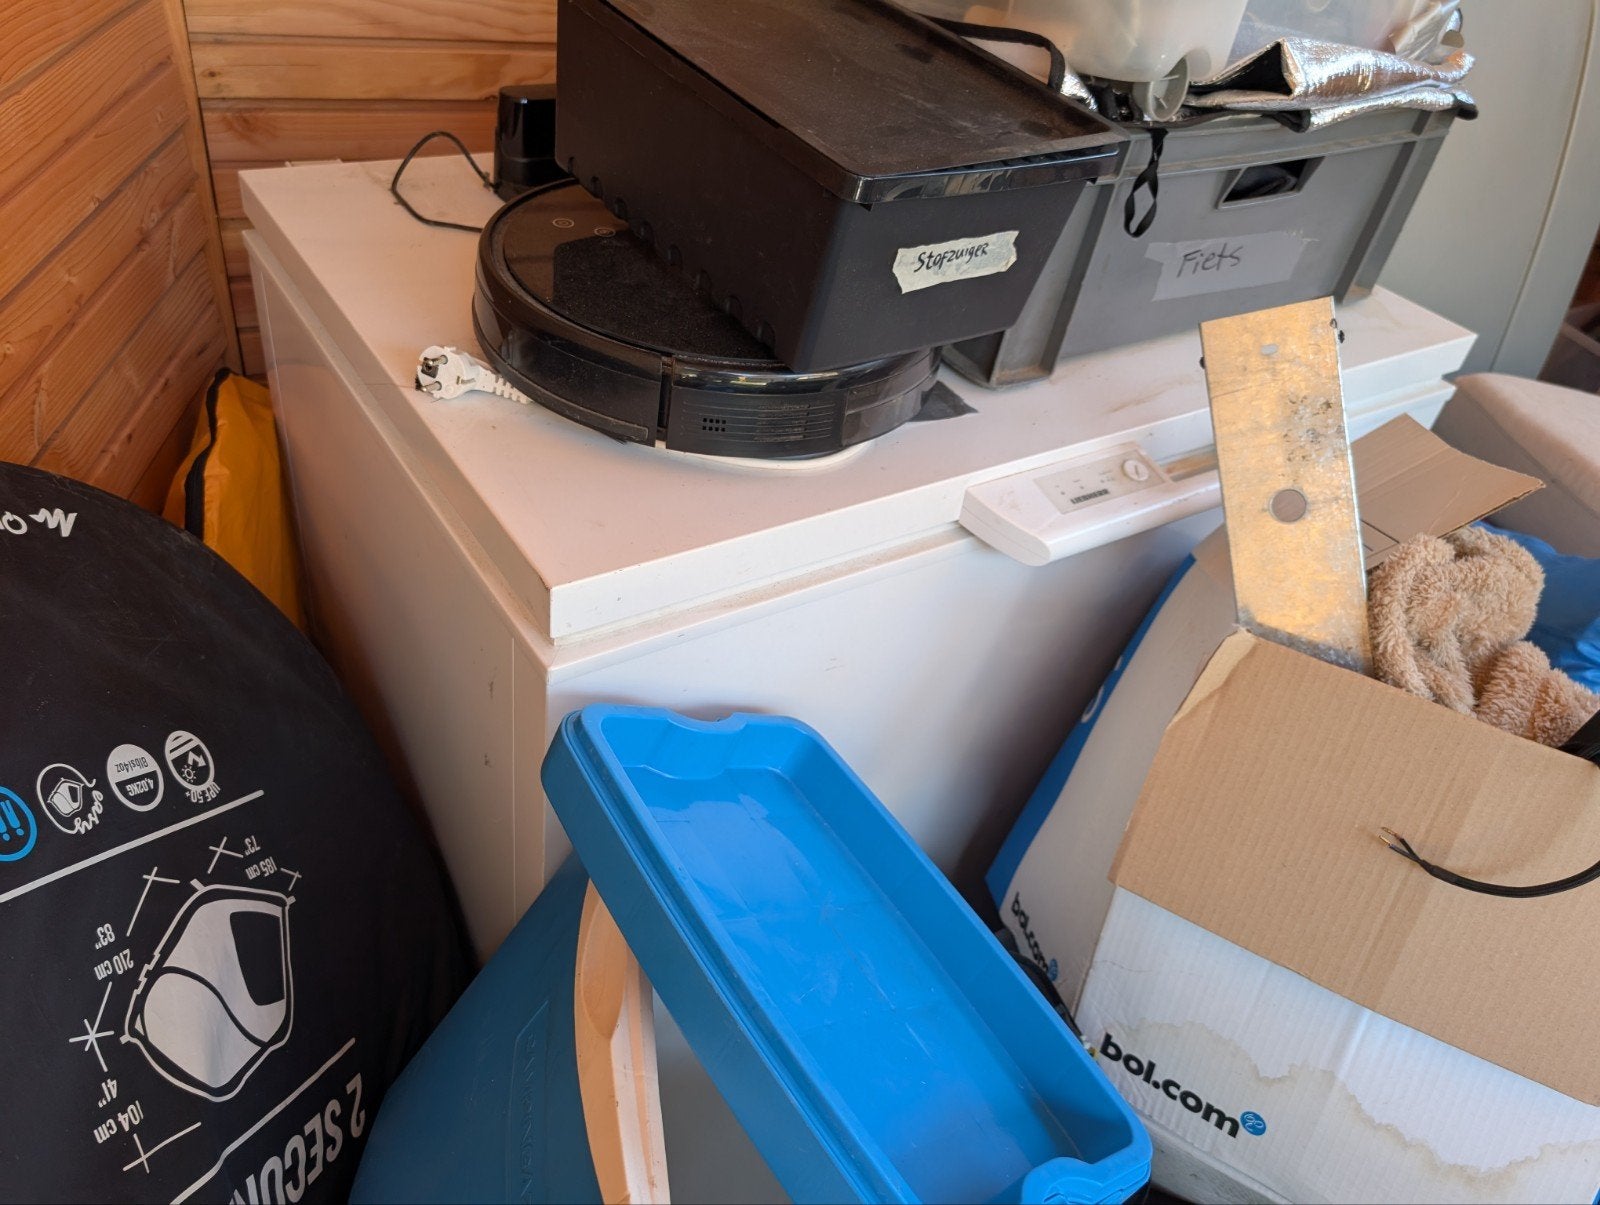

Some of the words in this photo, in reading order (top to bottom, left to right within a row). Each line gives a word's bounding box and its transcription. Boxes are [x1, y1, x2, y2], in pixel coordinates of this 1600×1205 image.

[1176, 242, 1243, 278] Fiets
[125, 778, 154, 797] 4,02KG
[206, 781, 221, 802] UPF
[73, 789, 104, 835] easy
[245, 864, 260, 880] cm
[259, 856, 278, 878] 185
[94, 959, 113, 981] cm
[112, 948, 135, 975] 210
[1100, 1033, 1240, 1138] bol.com
[117, 1100, 144, 1133] 104
[345, 1072, 366, 1138] 2
[93, 1117, 118, 1144] cm
